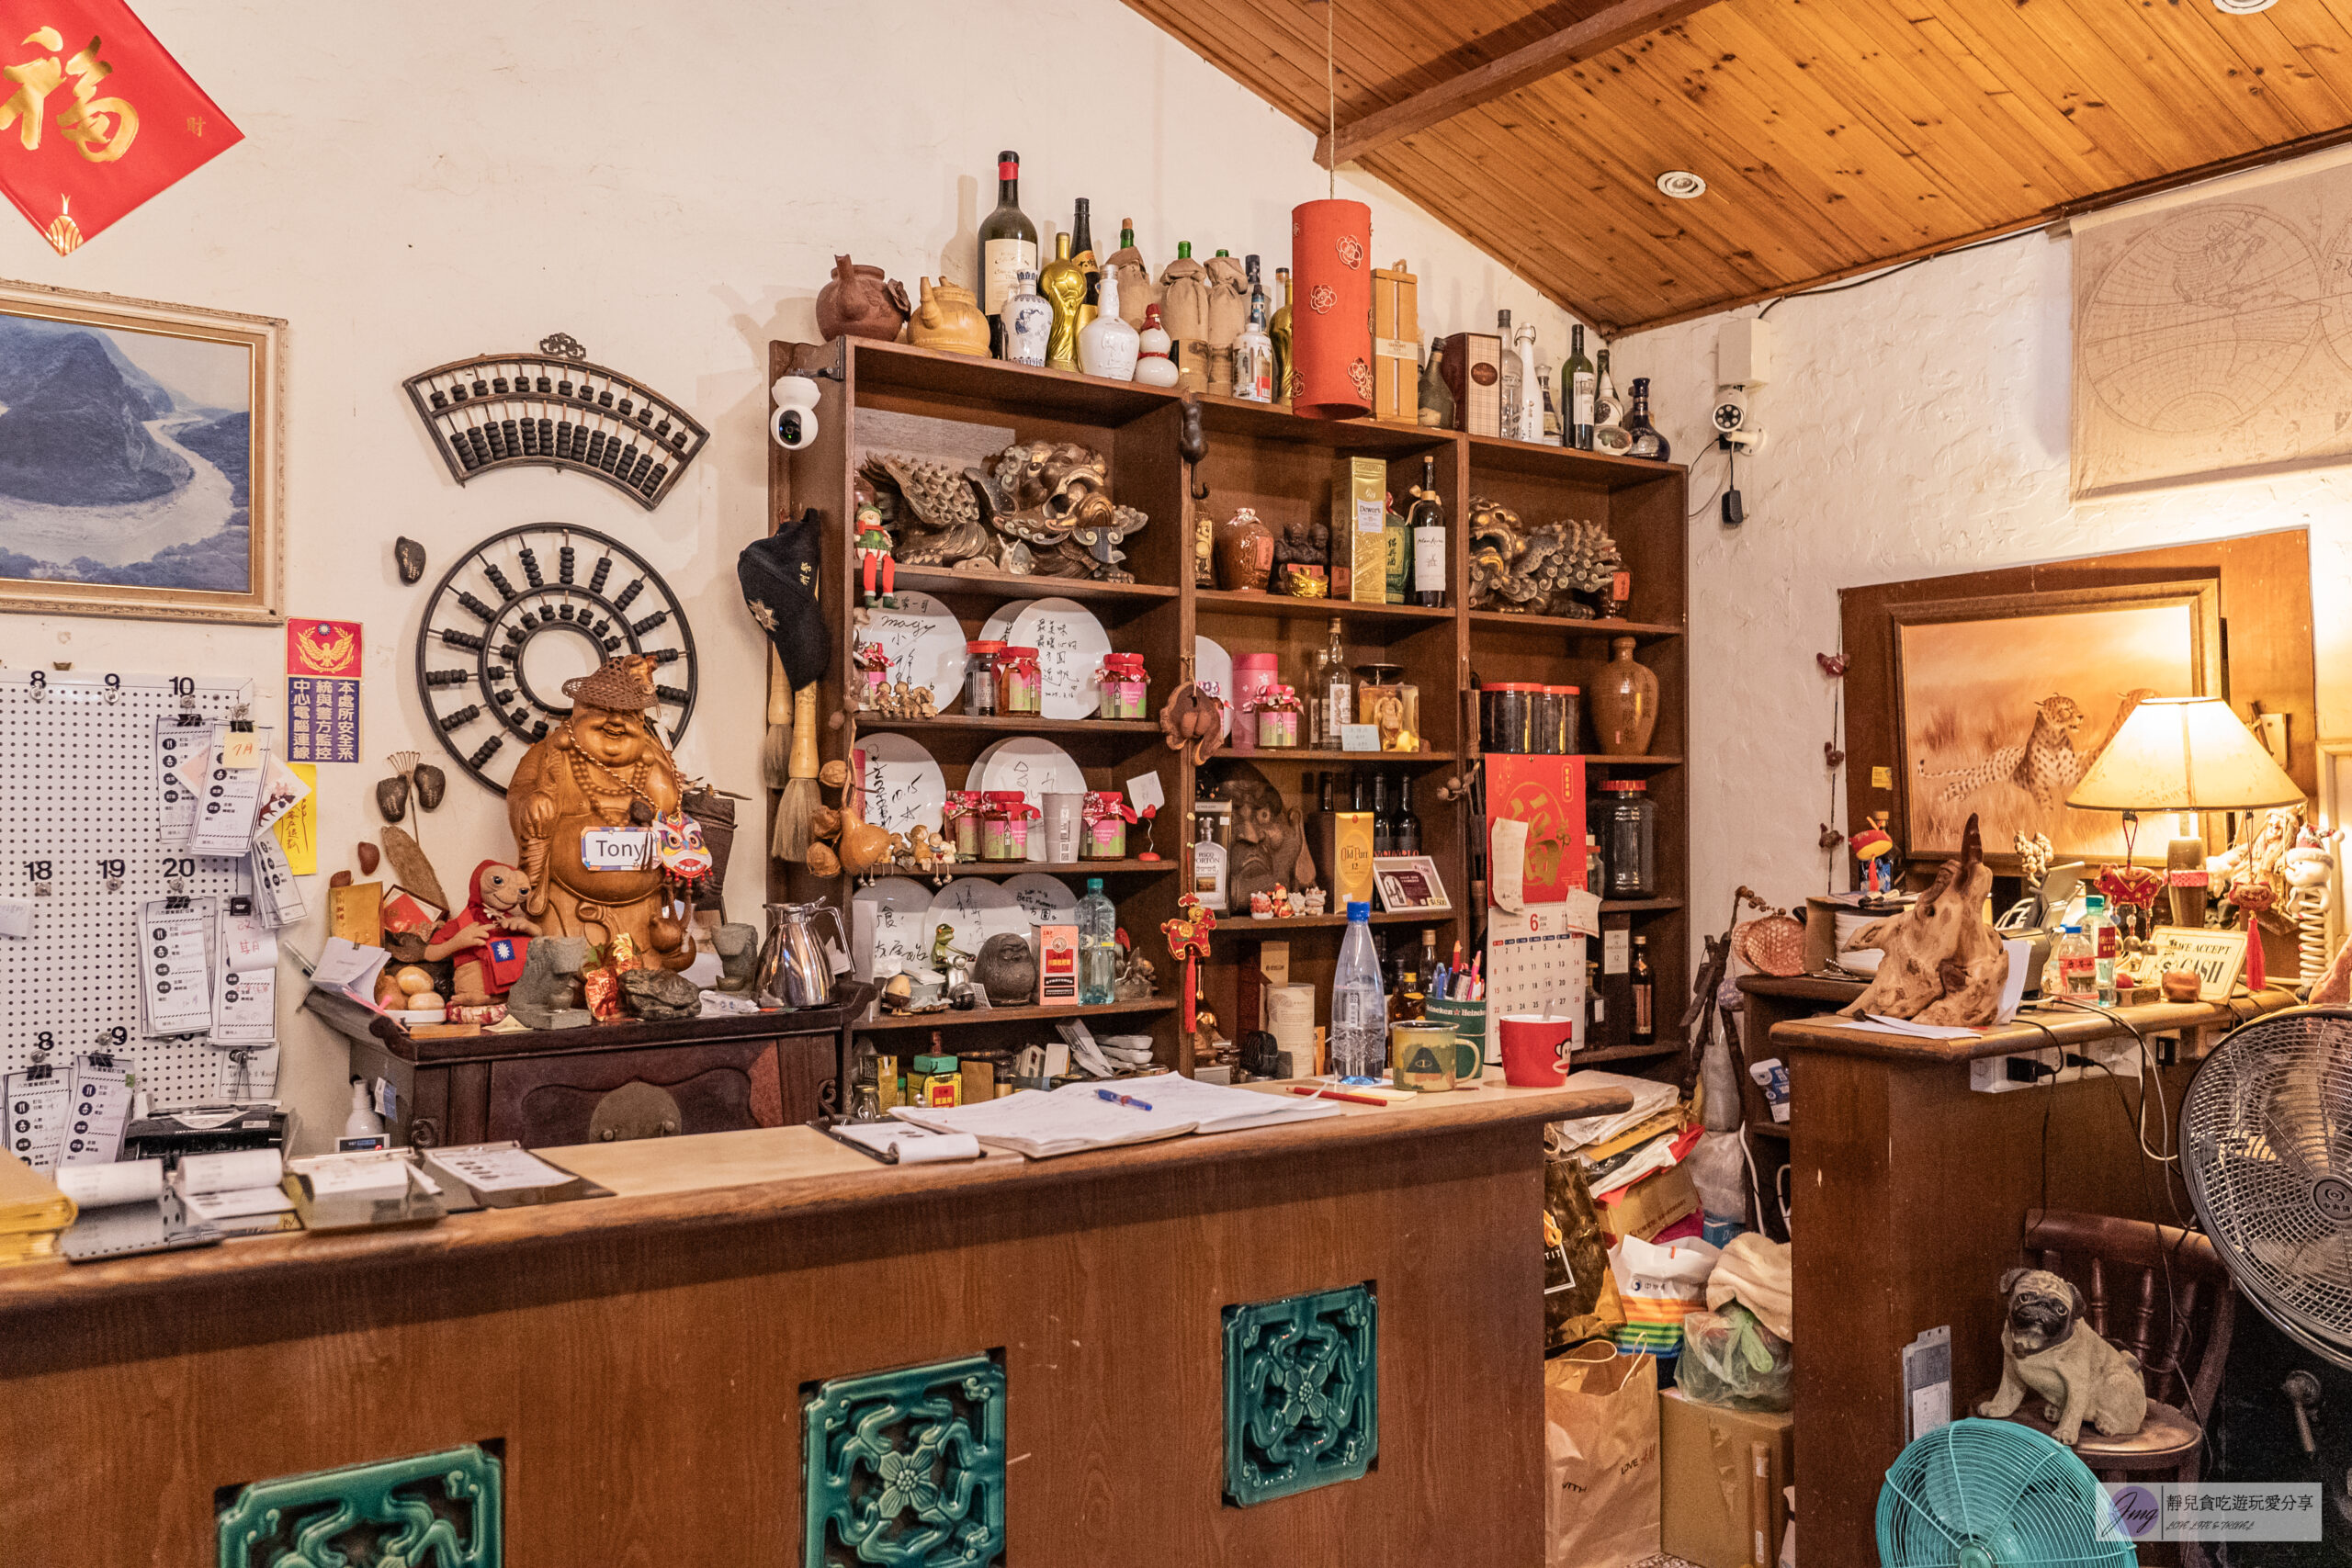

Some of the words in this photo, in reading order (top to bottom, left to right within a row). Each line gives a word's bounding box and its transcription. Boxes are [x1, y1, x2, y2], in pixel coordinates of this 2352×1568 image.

[0, 26, 139, 163] 福
[30, 671, 46, 689] 8
[105, 673, 120, 691] 9
[169, 677, 195, 695] 10
[293, 679, 311, 760] 中心電腦連線
[315, 681, 333, 760] 統與警方監控
[337, 682, 355, 761] 本處所安全系
[595, 840, 645, 861] Tony
[25, 861, 52, 882] 18
[98, 859, 125, 879] 19
[163, 858, 195, 877] 20
[1530, 913, 1539, 931] 6
[2195, 943, 2233, 955] ACCEPT
[111, 1026, 128, 1045] 9
